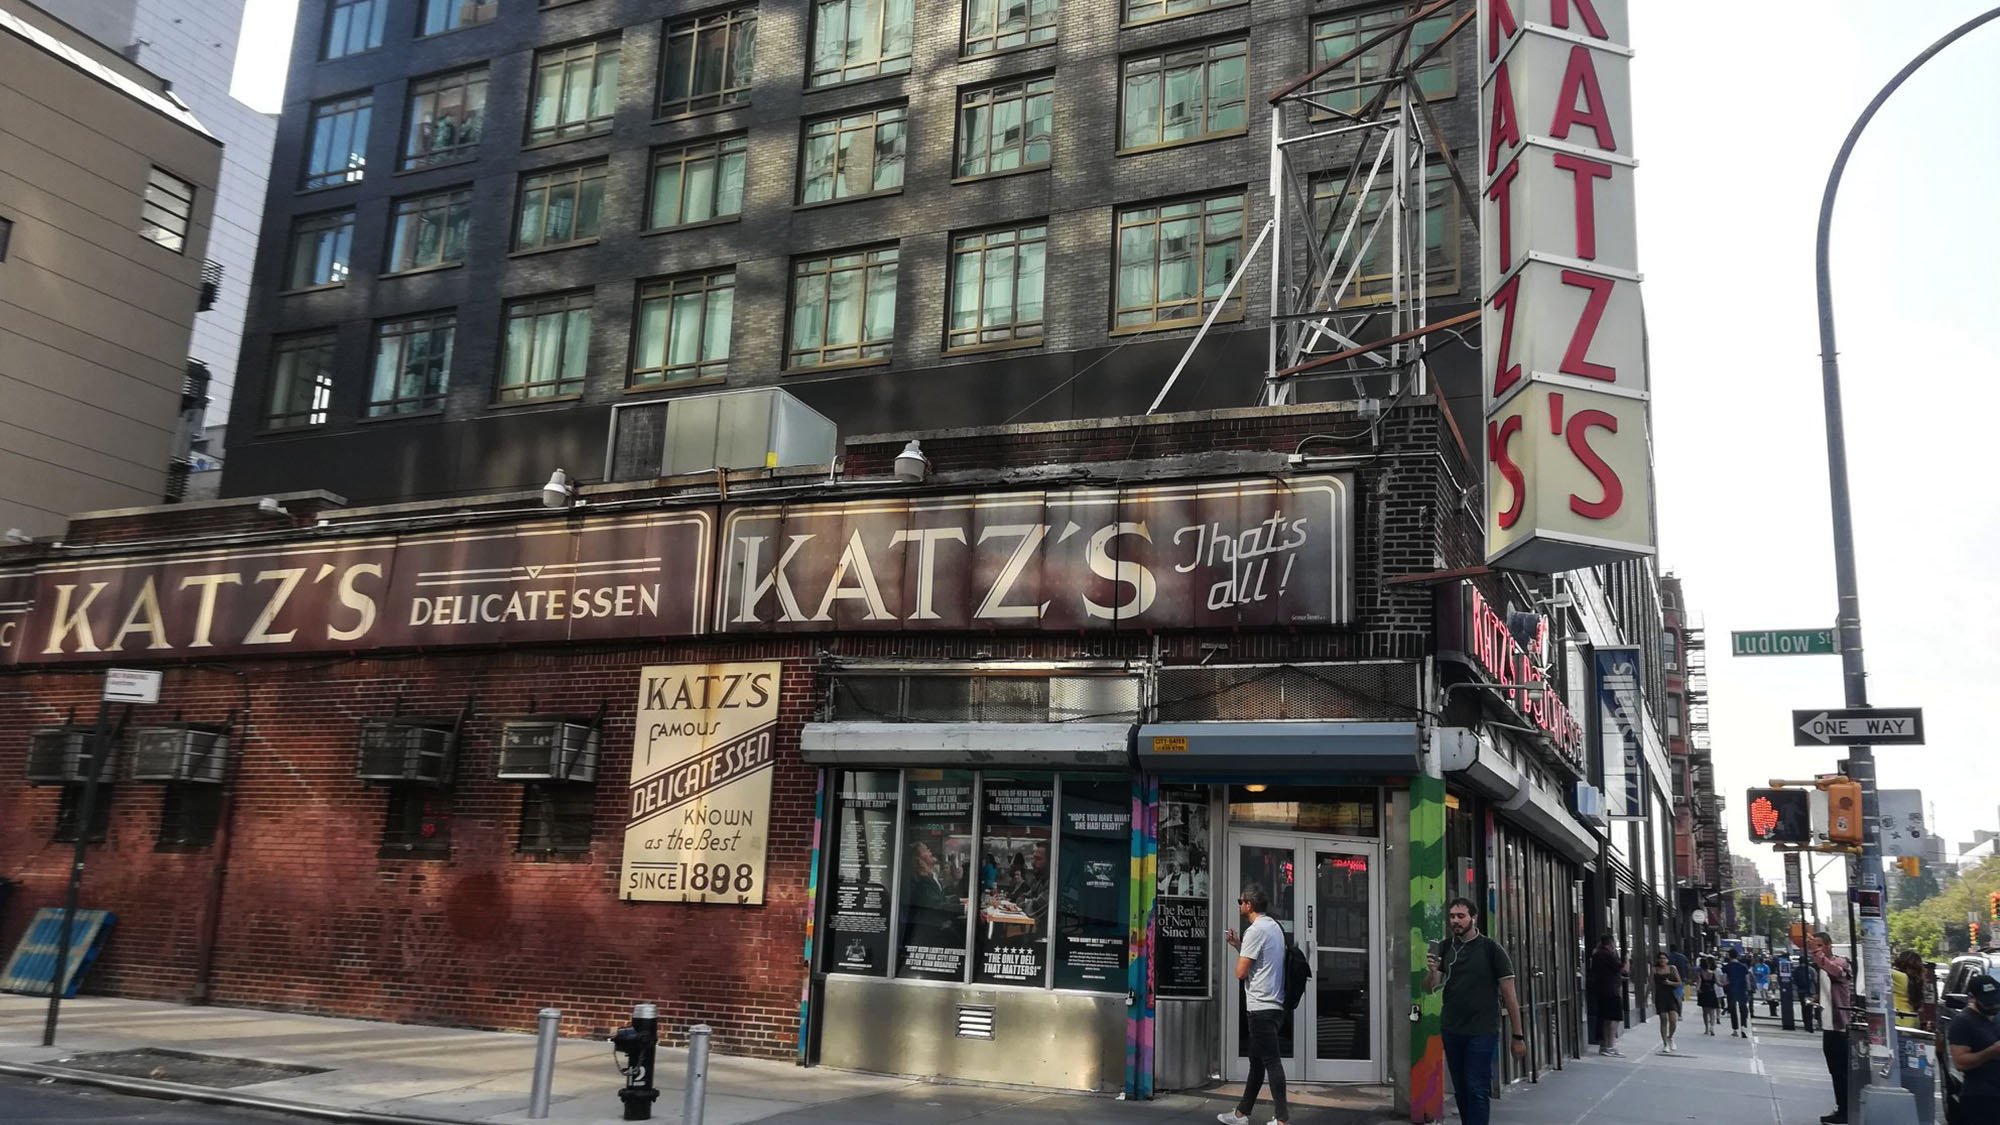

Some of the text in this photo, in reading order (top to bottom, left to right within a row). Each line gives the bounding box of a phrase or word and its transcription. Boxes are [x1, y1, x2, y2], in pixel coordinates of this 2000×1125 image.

[1173, 510, 1307, 573] That's
[730, 520, 1157, 623] KATZ'S
[45, 564, 382, 654] KATZ'S
[408, 583, 661, 626] DELICATESSEN
[1735, 632, 1831, 654] Ludlow St
[644, 672, 771, 711] KATZ'S
[1813, 719, 1905, 735] ONE WAY
[631, 732, 770, 819] DELICATESSEN
[645, 829, 742, 852] as the Best
[628, 872, 677, 890] SINCE
[1158, 904, 1175, 916] The
[1177, 904, 1196, 916] Real
[1158, 914, 1171, 926] of
[1171, 915, 1193, 927] New
[1162, 926, 1190, 938] Since
[984, 952, 1035, 965] "THE ONLY DELI
[984, 963, 1041, 975] THAT MATTERS!"
